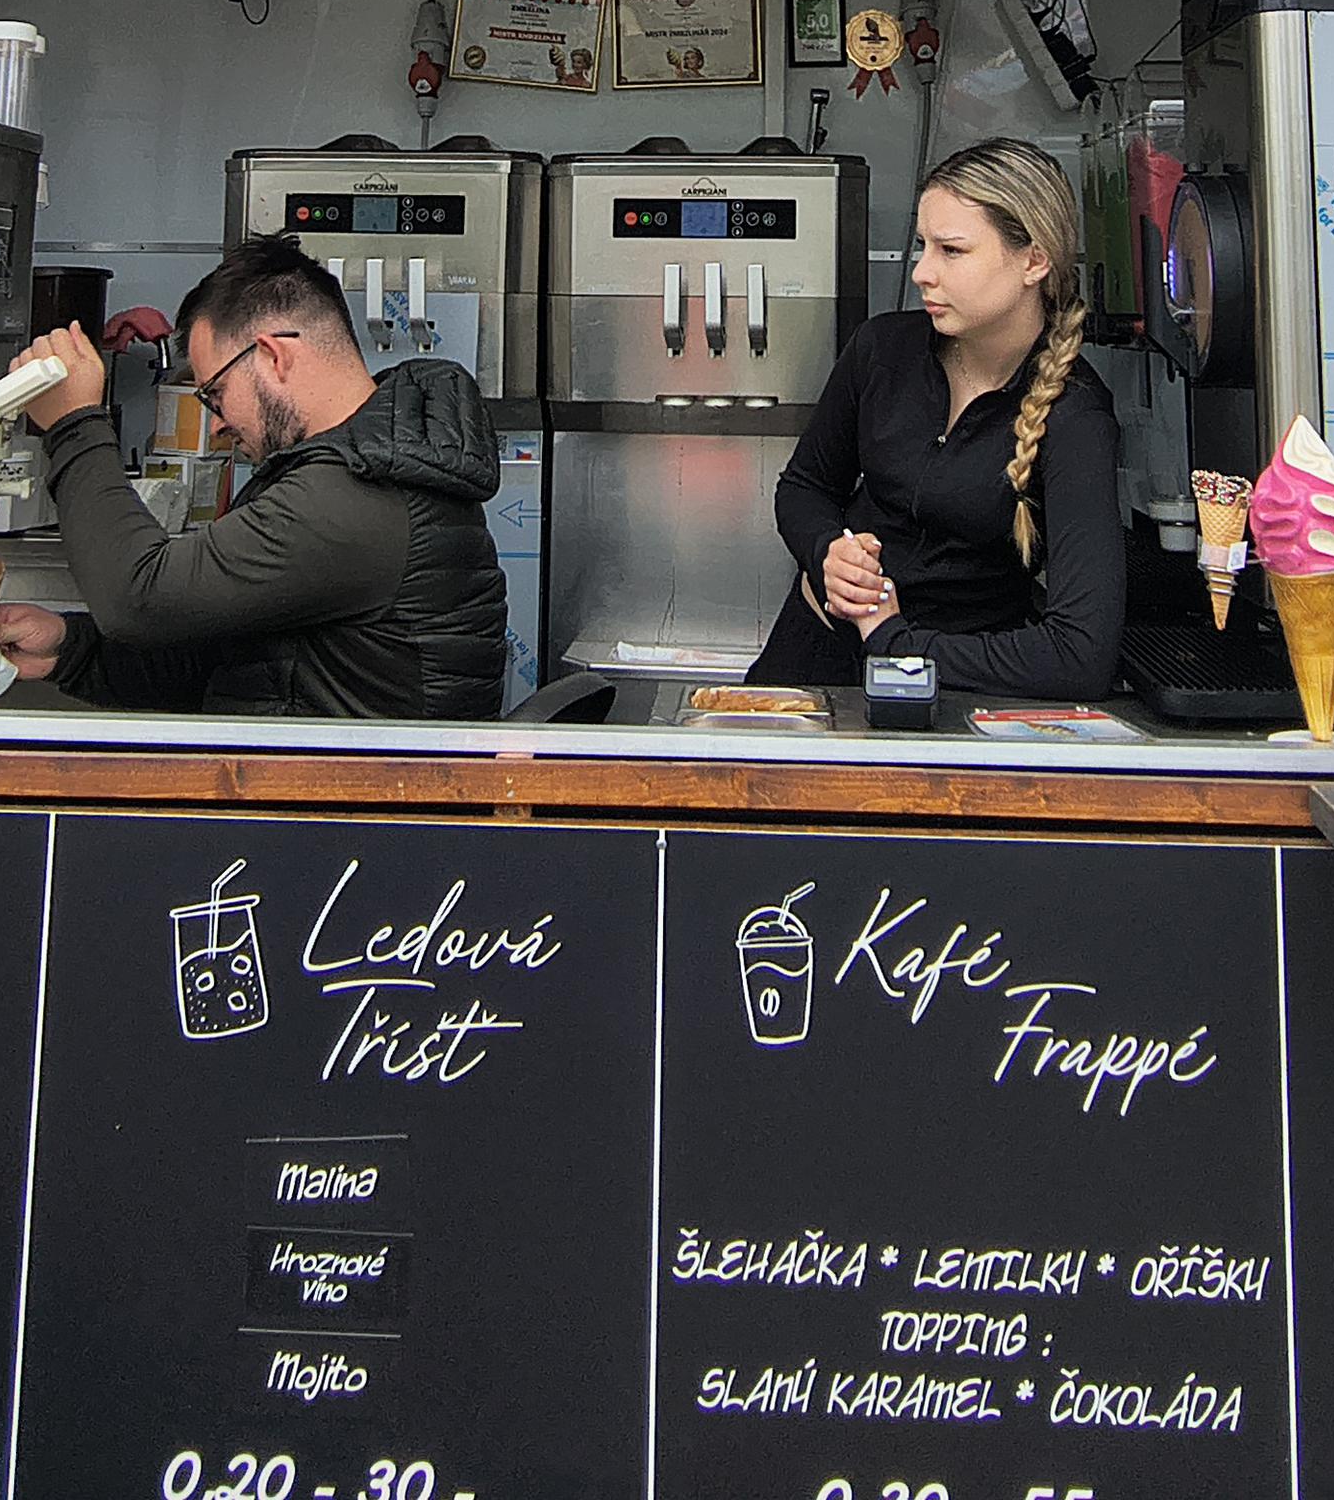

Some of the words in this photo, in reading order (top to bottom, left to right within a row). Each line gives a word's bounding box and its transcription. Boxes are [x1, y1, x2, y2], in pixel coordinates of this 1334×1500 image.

[302, 859, 563, 975] Ledová
[834, 887, 1011, 1024] Kafé
[321, 978, 524, 1082] Tříšť
[995, 983, 1217, 1116] Frappé
[276, 1162, 378, 1203] Malina
[269, 1243, 389, 1277] Hroznové
[302, 1278, 348, 1303] víno
[672, 1229, 868, 1288] ŠLEHAČKA
[913, 1248, 1087, 1296] LENTILKY
[1130, 1244, 1271, 1301] OŘÍŠKY
[881, 1311, 1028, 1357] TOPPING
[267, 1350, 368, 1401] Mojito
[697, 1358, 818, 1414] SLANÝ
[826, 1371, 1002, 1420] KARAMEL
[1049, 1367, 1243, 1432] ČOKOLÁDA
